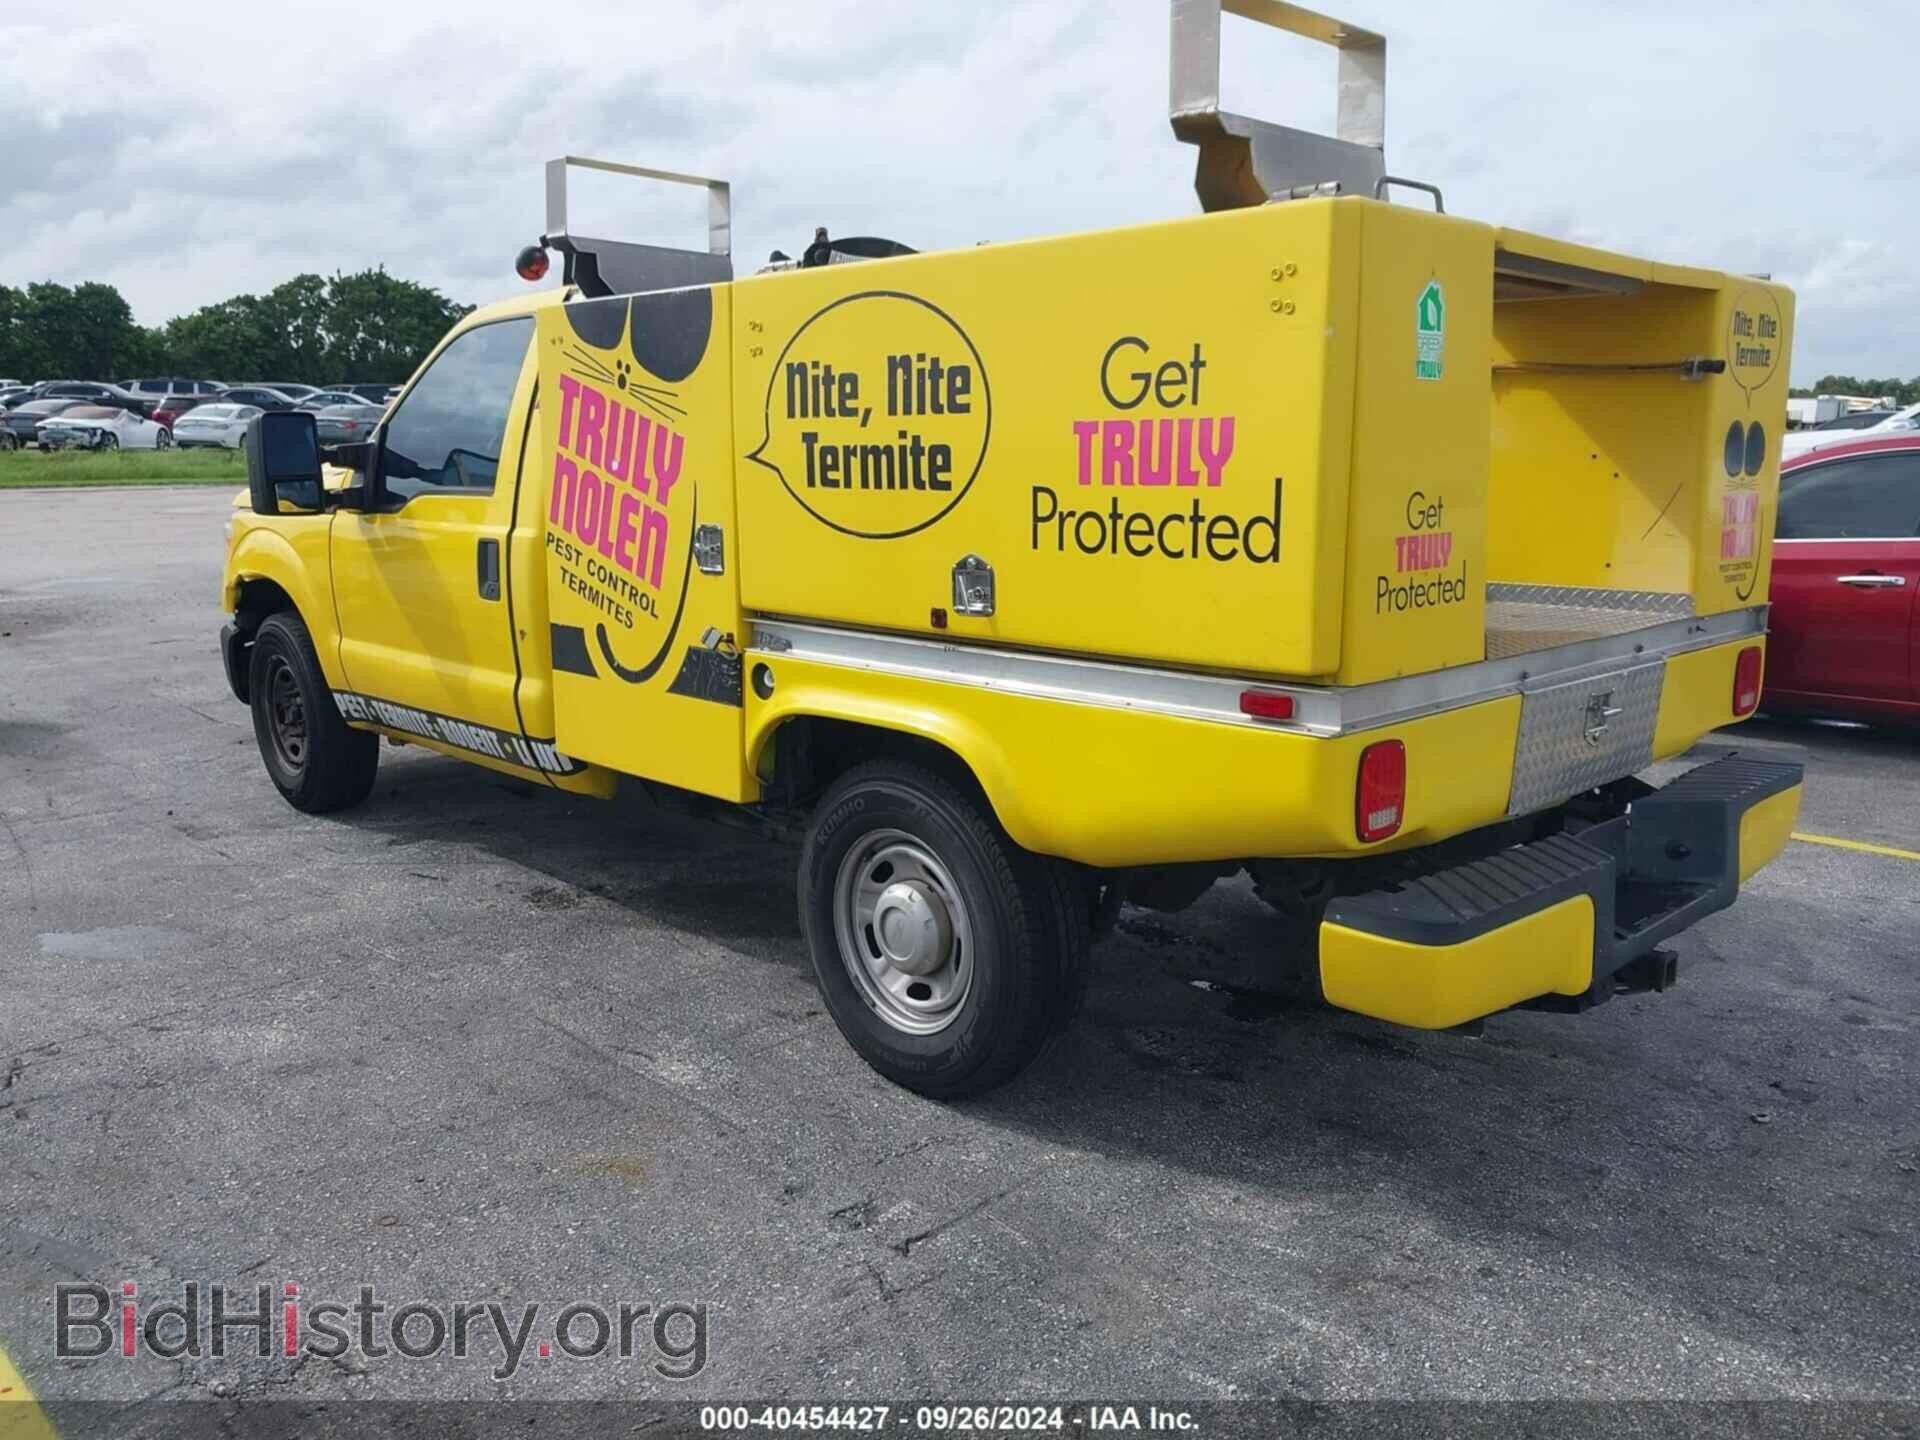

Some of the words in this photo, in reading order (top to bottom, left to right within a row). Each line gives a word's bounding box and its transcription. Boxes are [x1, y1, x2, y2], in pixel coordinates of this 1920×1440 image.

[786, 360, 872, 428] Nite,
[887, 353, 971, 416] Nite
[1100, 335, 1207, 410] Get
[1735, 342, 1770, 368] Termite
[558, 373, 686, 506] TRULY
[801, 430, 952, 491] Termite
[1073, 416, 1235, 487] TRULY
[549, 451, 669, 591] NOLEN
[1031, 477, 1283, 564] Protected
[1406, 491, 1444, 530] Get
[546, 531, 583, 567] PEST
[587, 558, 659, 620] CONTROL
[1376, 560, 1466, 614] Protected
[1396, 531, 1452, 573] TRULY
[560, 566, 634, 629] TERMITES
